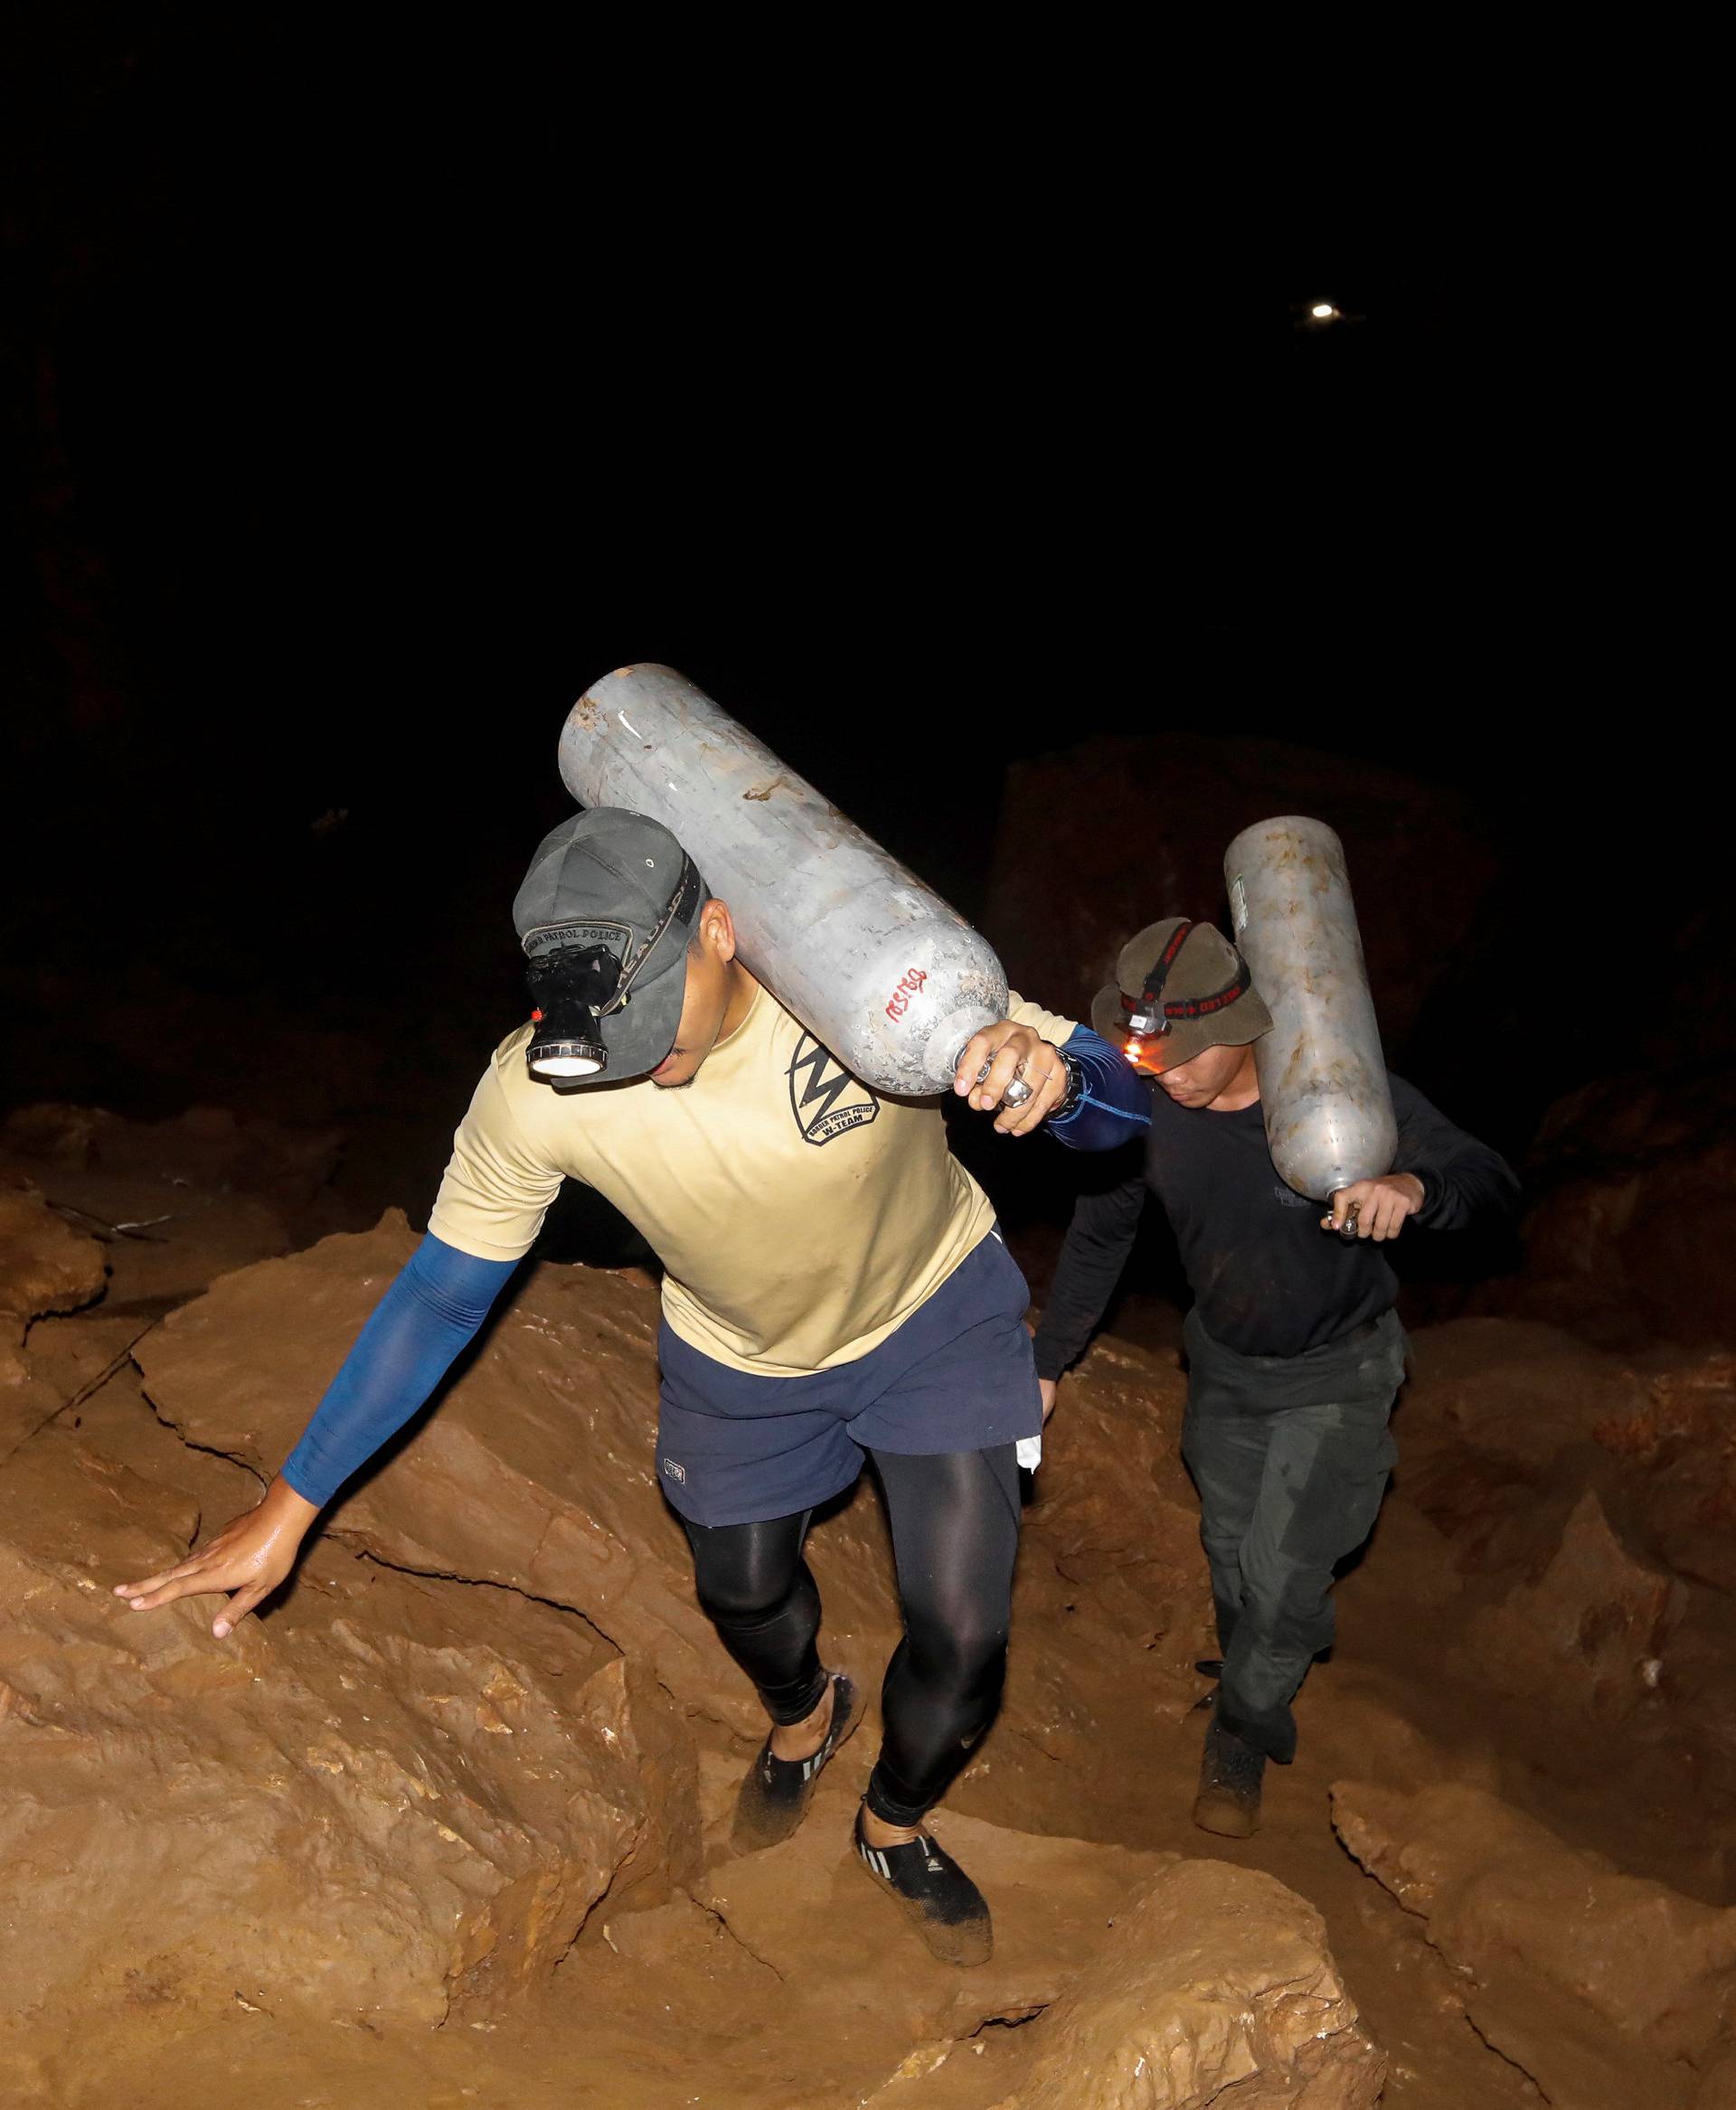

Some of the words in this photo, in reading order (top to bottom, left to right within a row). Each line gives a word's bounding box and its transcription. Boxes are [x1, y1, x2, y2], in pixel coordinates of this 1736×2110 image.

[543, 929, 579, 941] PATROL
[582, 929, 621, 941] POLICE
[830, 1110, 851, 1123] PATROL
[852, 1106, 873, 1116] POLICE
[822, 1114, 863, 1136] W-TEAM
